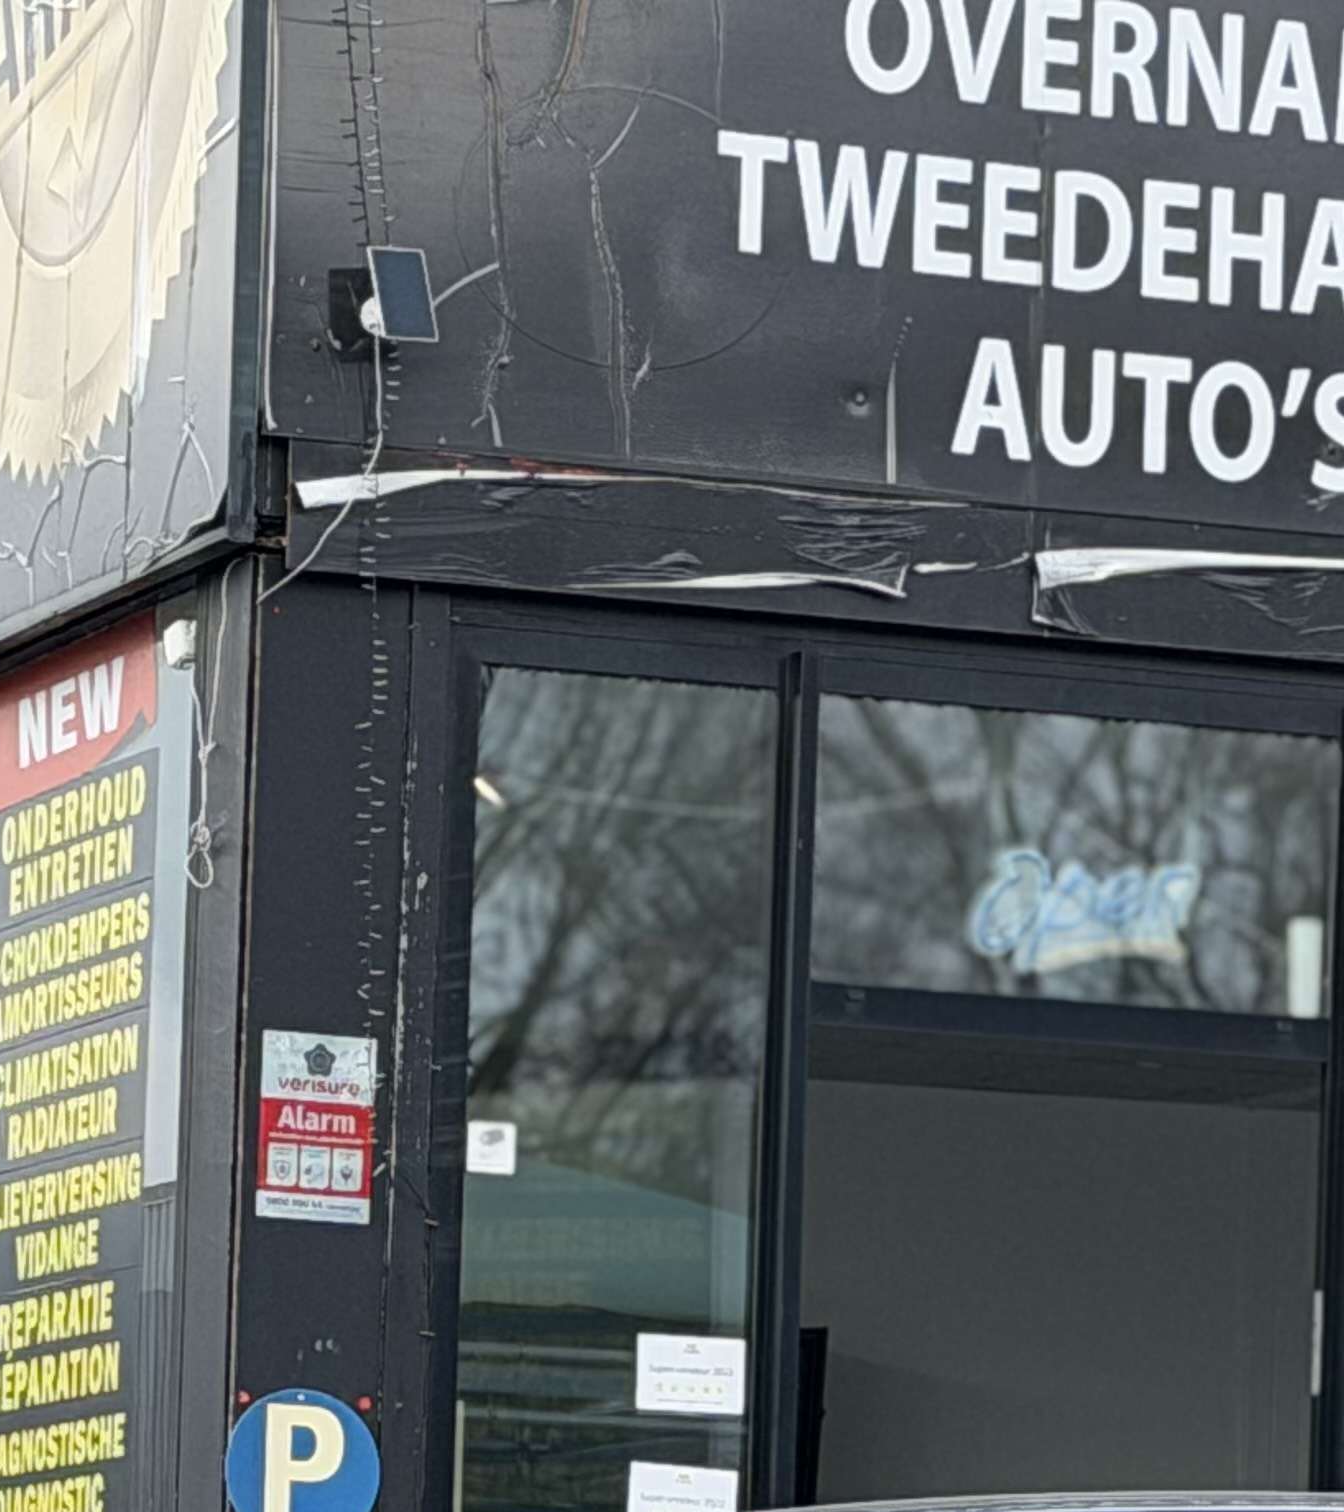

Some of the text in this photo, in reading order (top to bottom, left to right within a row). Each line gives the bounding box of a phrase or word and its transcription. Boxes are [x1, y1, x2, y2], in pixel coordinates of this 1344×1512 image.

[17, 656, 127, 769] NEW
[1, 764, 147, 866] ONDERHOUD
[9, 823, 134, 917] ENTRETIEN
[6, 1085, 118, 1161] RADIATEUR
[276, 1104, 356, 1135] Alarm
[277, 1076, 362, 1098] verisure
[14, 1218, 101, 1282] VIDANGE
